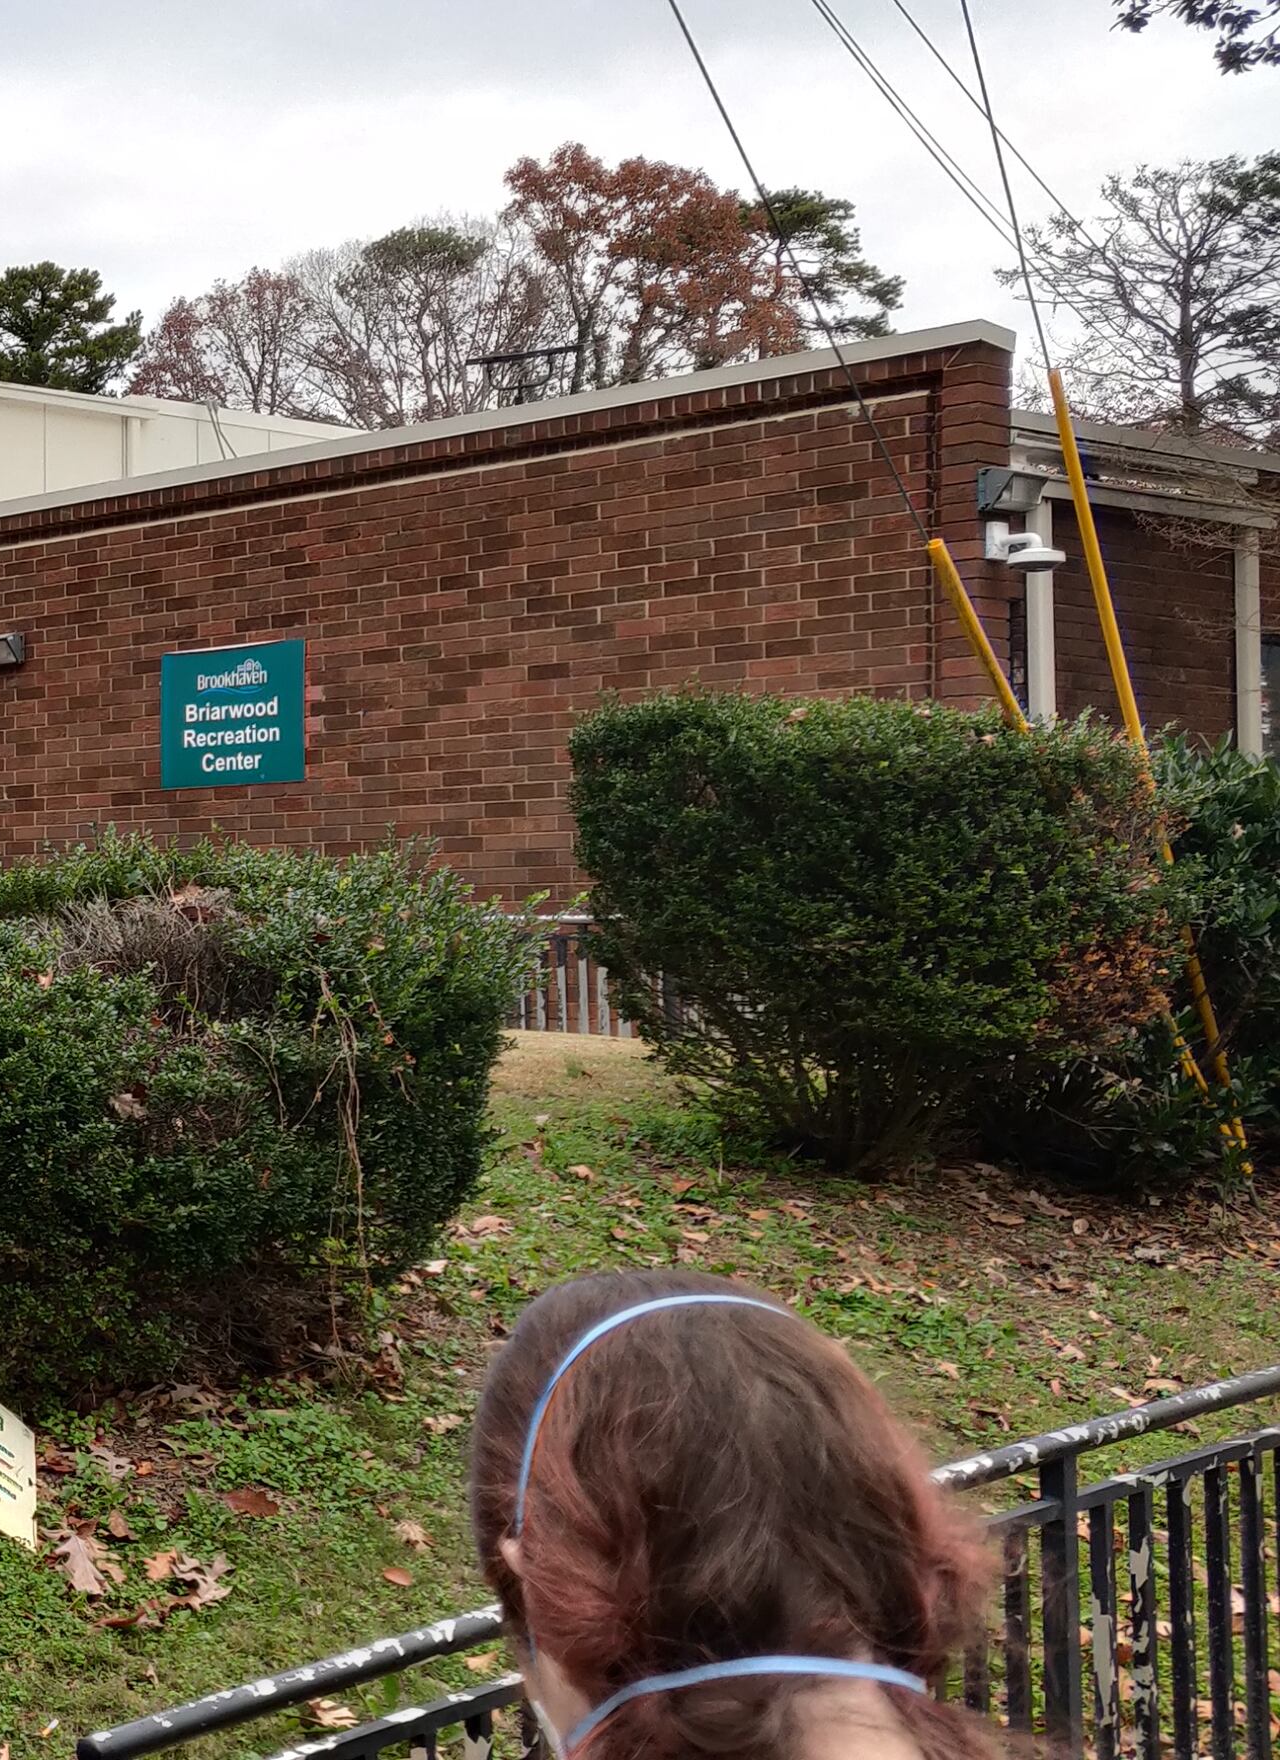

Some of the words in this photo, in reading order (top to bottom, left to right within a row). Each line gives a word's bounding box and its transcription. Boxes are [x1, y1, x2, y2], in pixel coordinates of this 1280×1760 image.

[197, 669, 268, 691] Brookhaven
[185, 696, 278, 722] Briarwood
[183, 723, 280, 749] Recreation
[202, 752, 262, 772] Center
